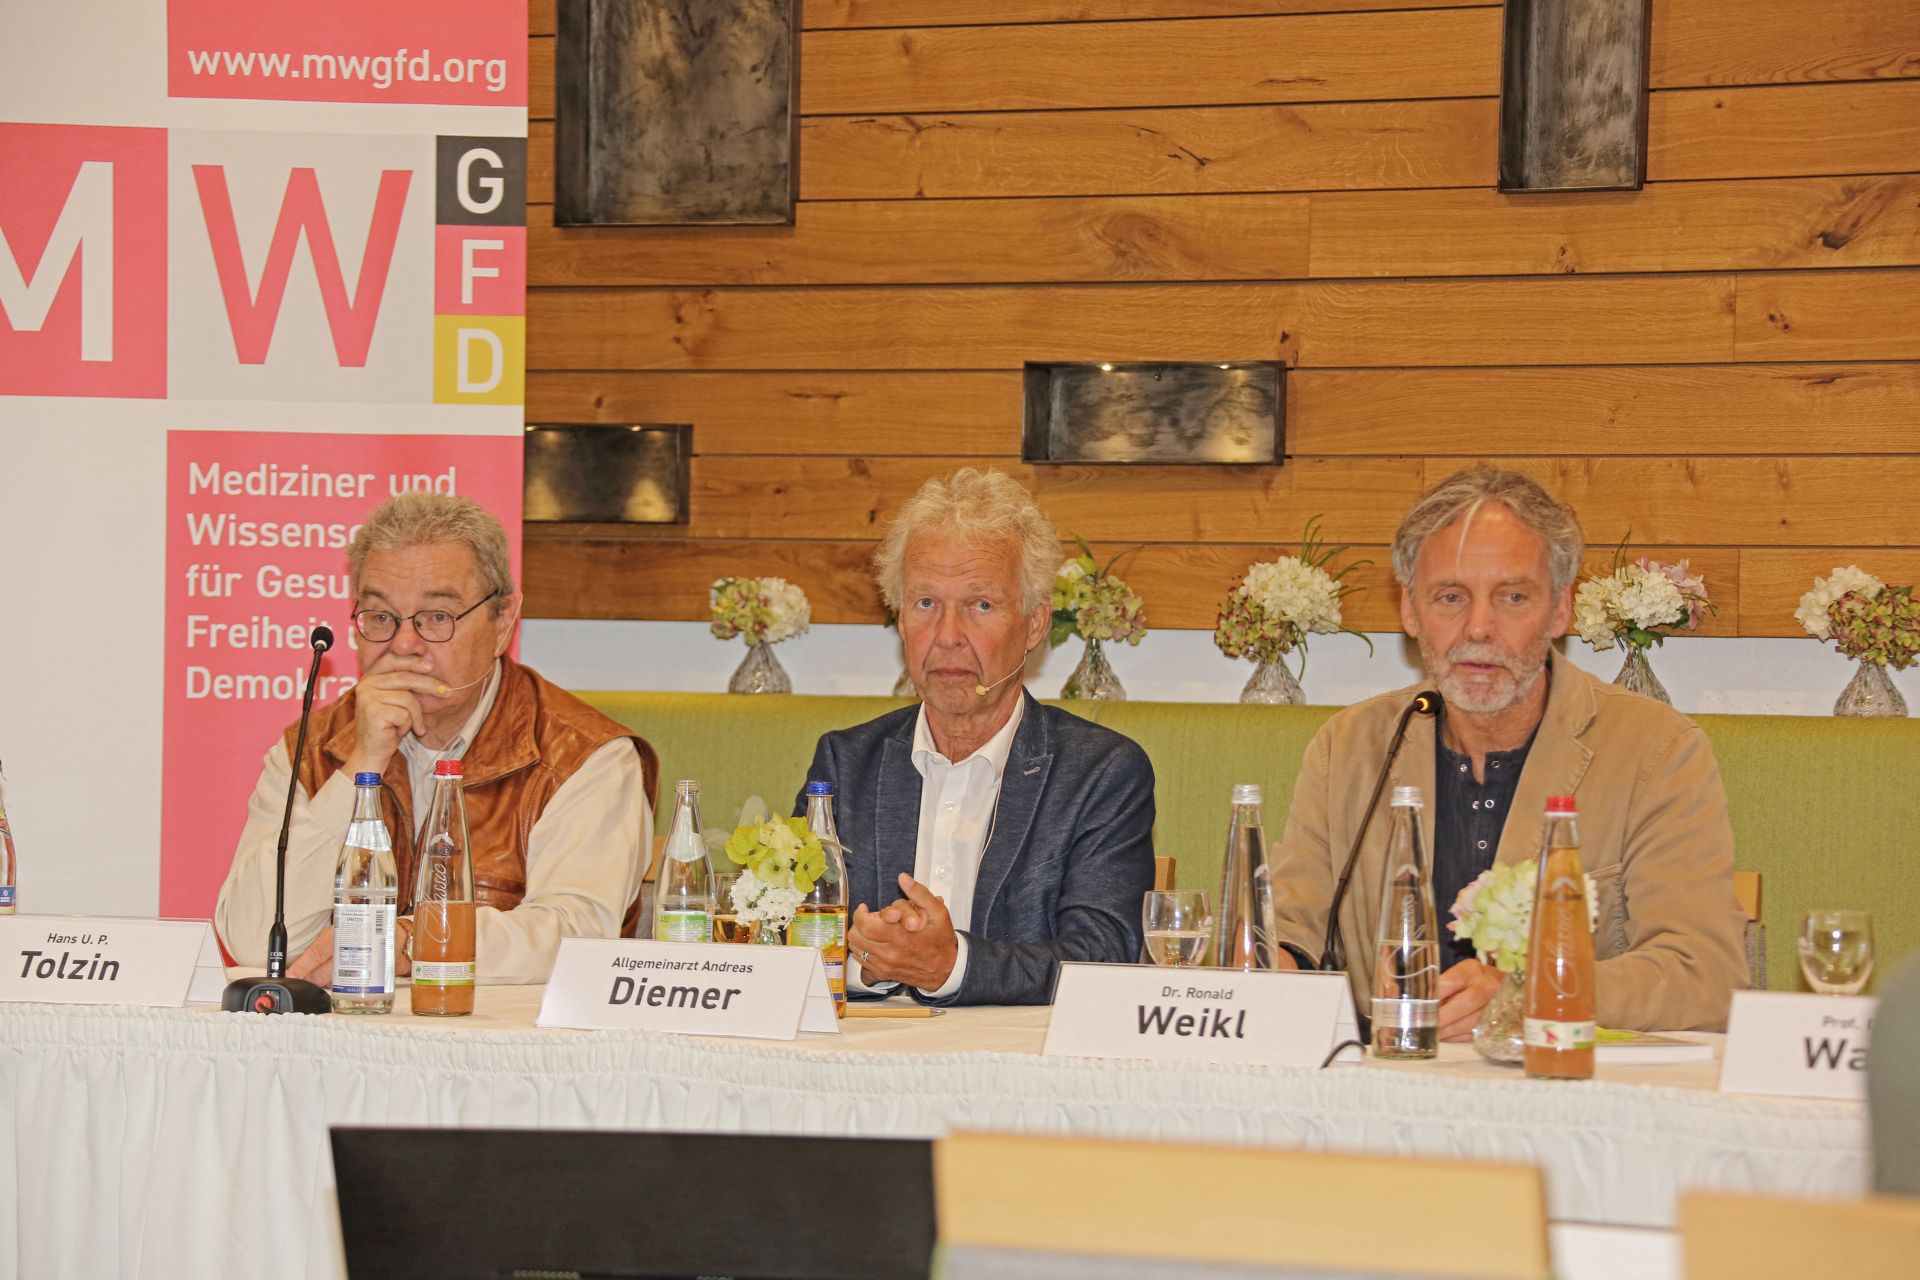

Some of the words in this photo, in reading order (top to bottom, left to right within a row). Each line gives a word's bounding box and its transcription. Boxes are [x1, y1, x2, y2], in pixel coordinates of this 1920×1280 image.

[188, 49, 508, 92] www.mwgfd.org
[188, 461, 376, 498] Mediziner
[389, 465, 456, 497] und
[186, 563, 243, 597] für
[47, 932, 77, 944] Hans
[81, 934, 94, 944] U.
[97, 935, 109, 945] P.
[21, 950, 120, 981] Tolzin
[612, 956, 699, 971] Allgemeinarzt
[701, 960, 754, 974] Andreas
[608, 976, 742, 1010] Diemer
[1162, 986, 1182, 998] Dr.
[1186, 987, 1235, 1000] Ronald
[1138, 1004, 1247, 1039] Weikl
